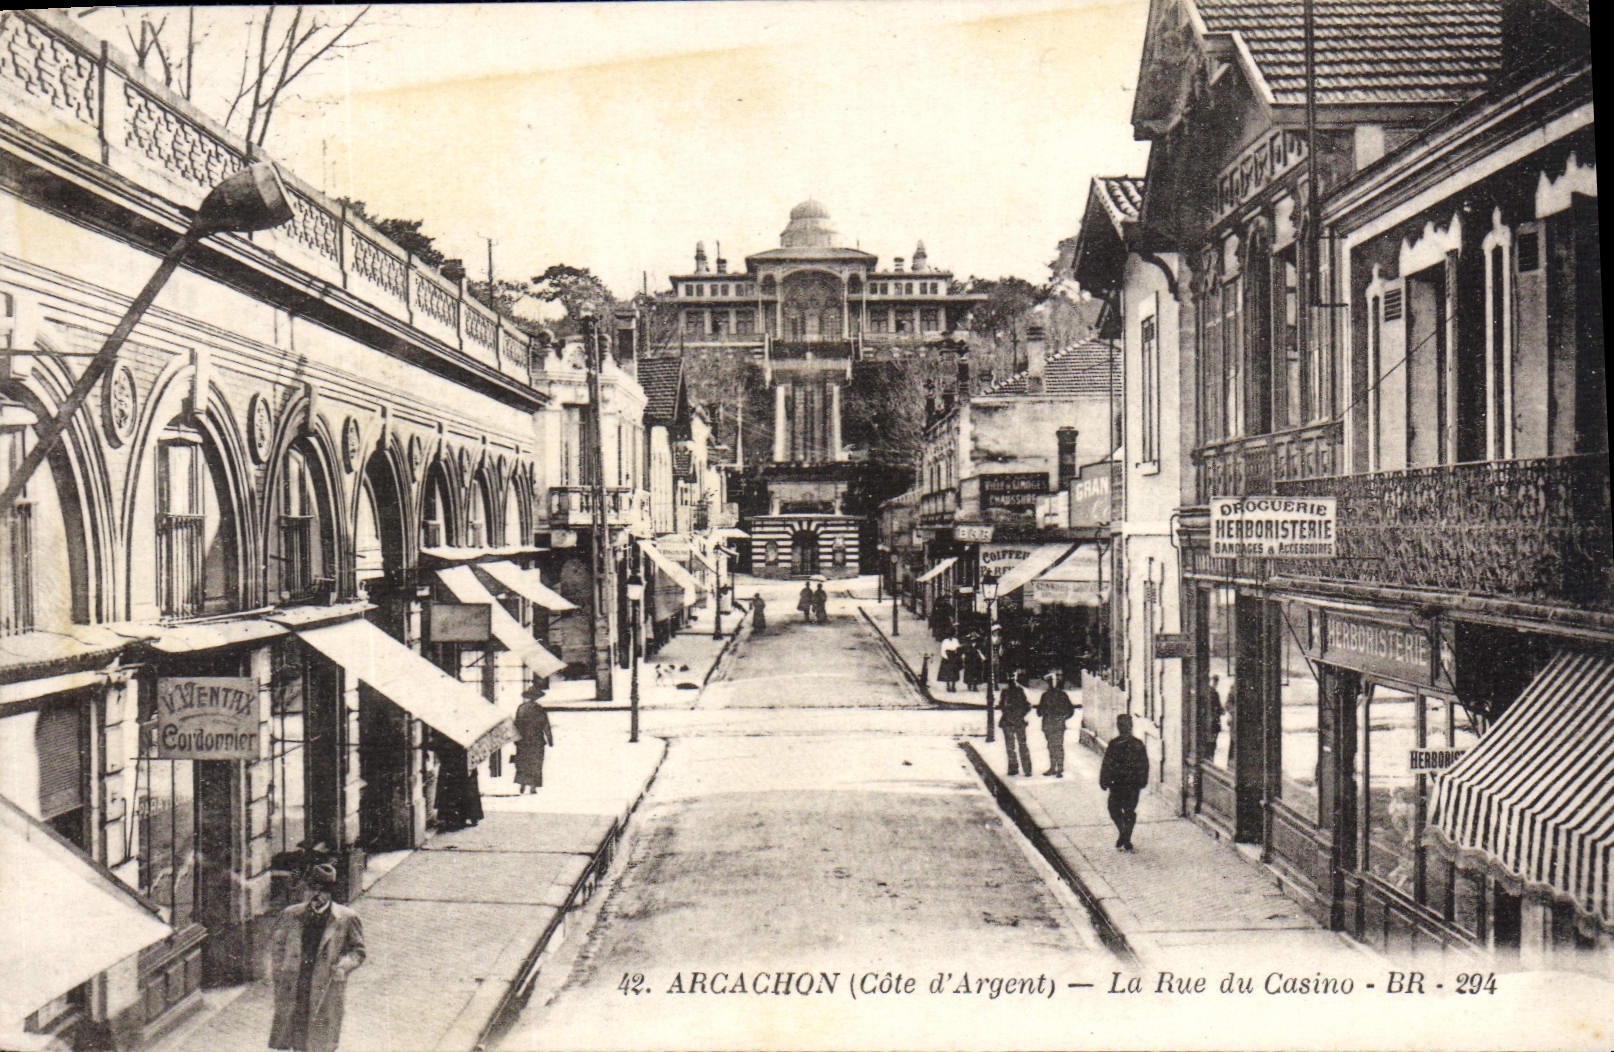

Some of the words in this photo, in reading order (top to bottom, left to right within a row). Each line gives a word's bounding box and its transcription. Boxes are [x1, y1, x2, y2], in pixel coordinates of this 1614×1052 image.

[1220, 500, 1328, 516] DROGUERIE
[1215, 519, 1332, 539] HERBORISTERIE
[1215, 541, 1264, 554] BANDAGES
[1279, 542, 1332, 555] ACCESSOIRES
[1327, 618, 1428, 667] HERBORISTERIE
[162, 723, 257, 751] Cordonnier
